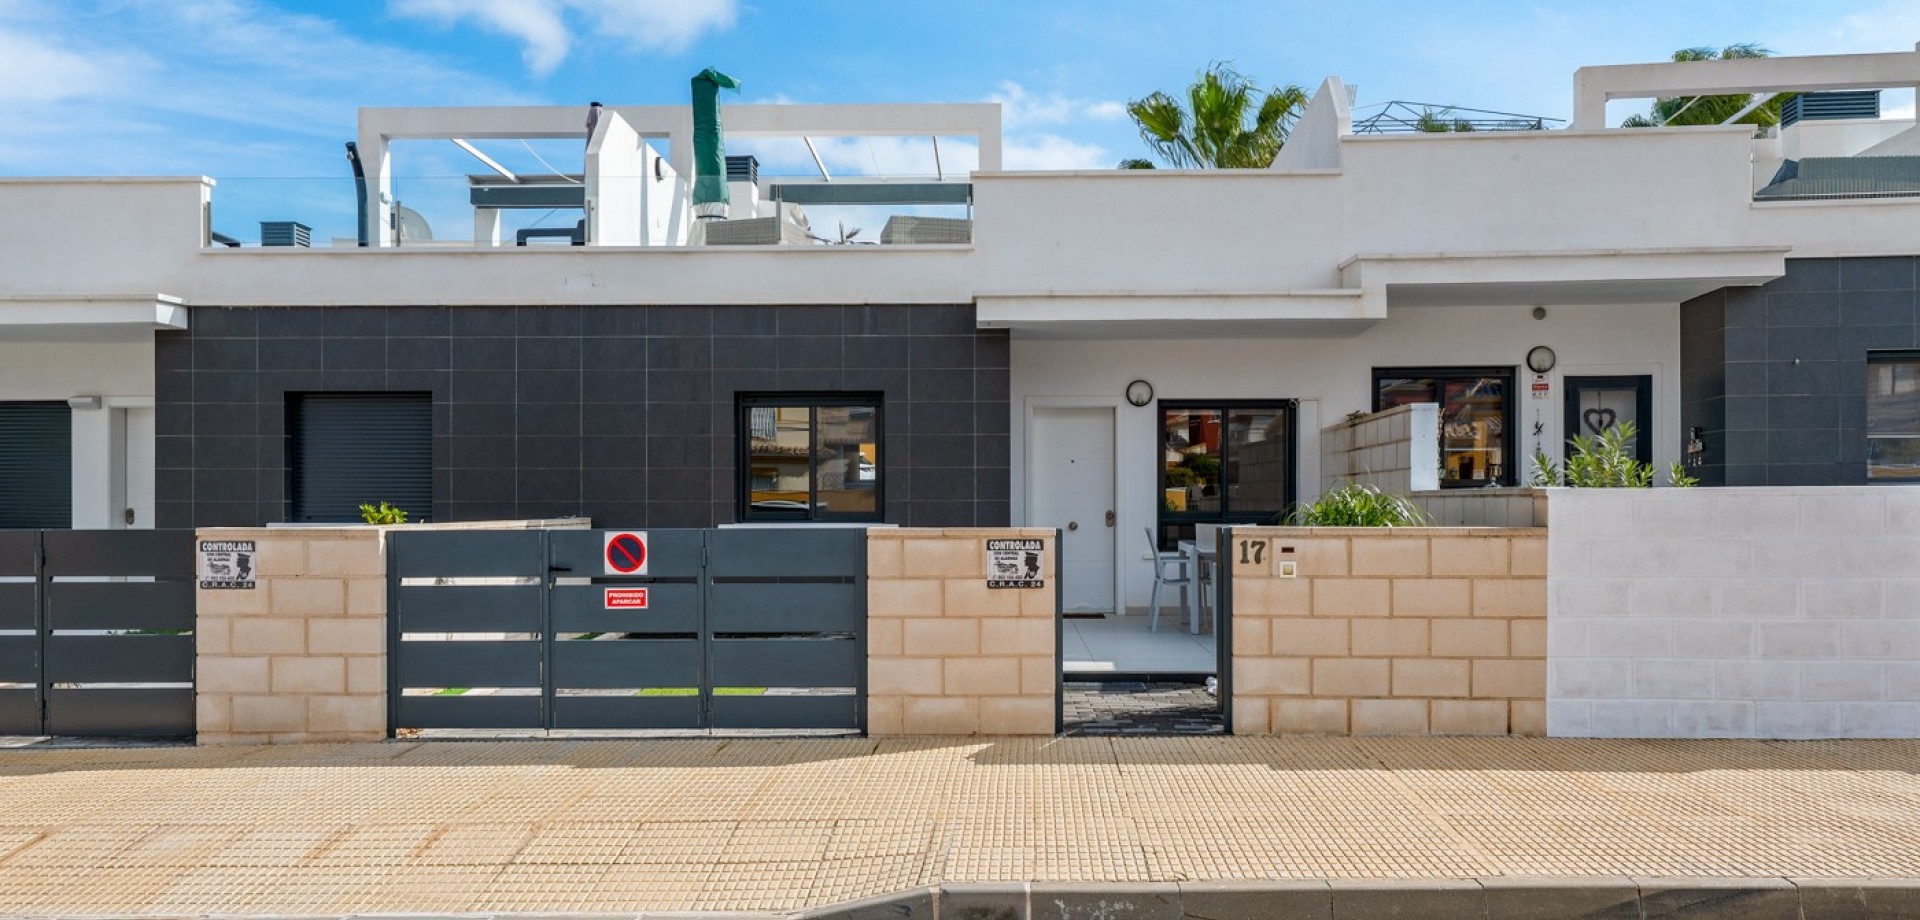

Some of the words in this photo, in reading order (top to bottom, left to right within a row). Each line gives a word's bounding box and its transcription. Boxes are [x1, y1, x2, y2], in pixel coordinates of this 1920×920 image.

[202, 542, 253, 551] CONTROLADA
[990, 541, 1041, 550] CONTROLADA
[1240, 540, 1266, 565] 17
